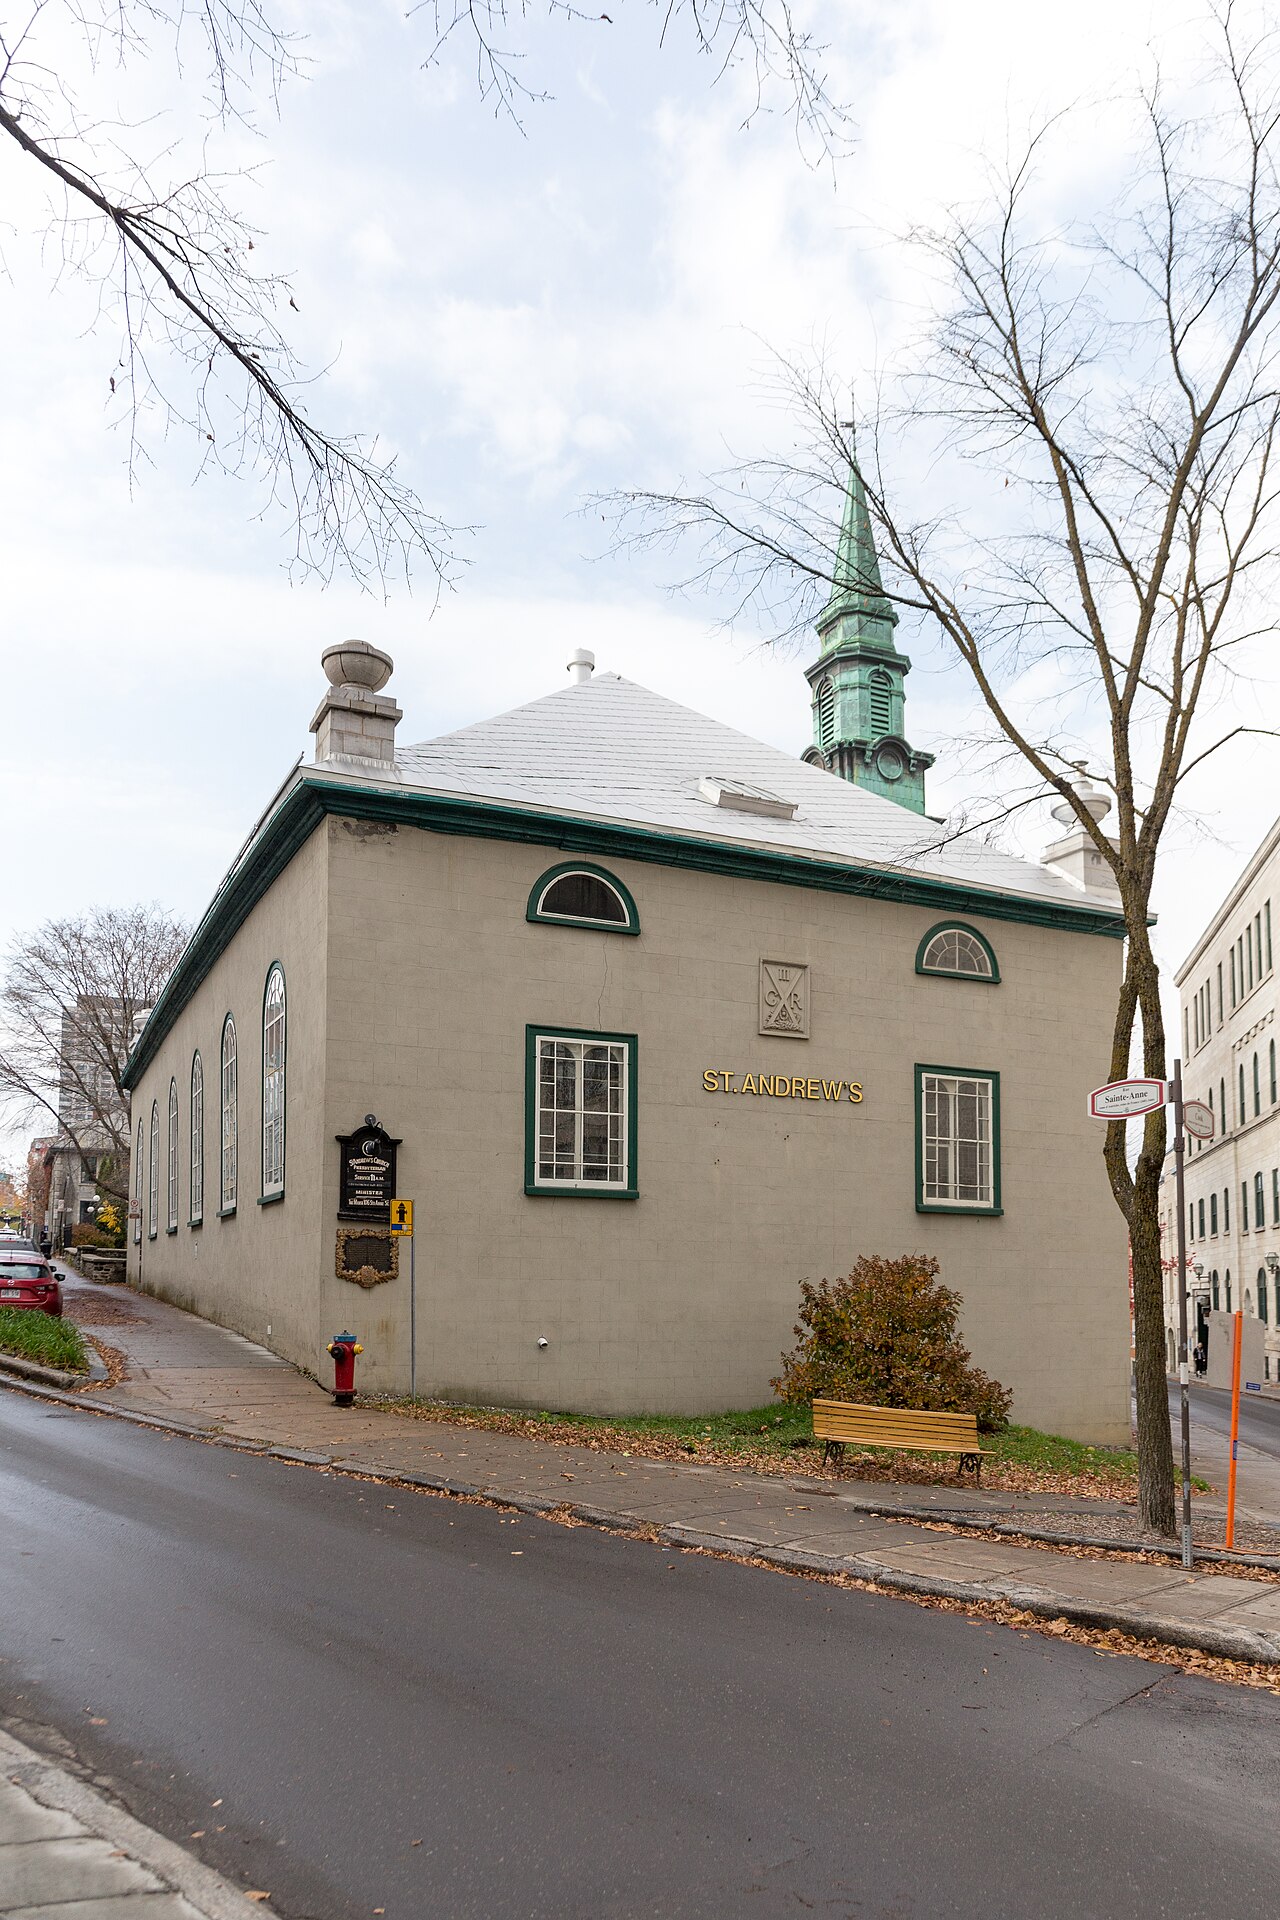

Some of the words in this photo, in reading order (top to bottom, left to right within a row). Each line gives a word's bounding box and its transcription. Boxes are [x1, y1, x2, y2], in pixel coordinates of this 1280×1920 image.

[790, 993, 803, 1010] R
[702, 1069, 738, 1093] ST.
[741, 1073, 864, 1103] ANDREW'S
[1104, 1091, 1149, 1104] Sainte-Anne
